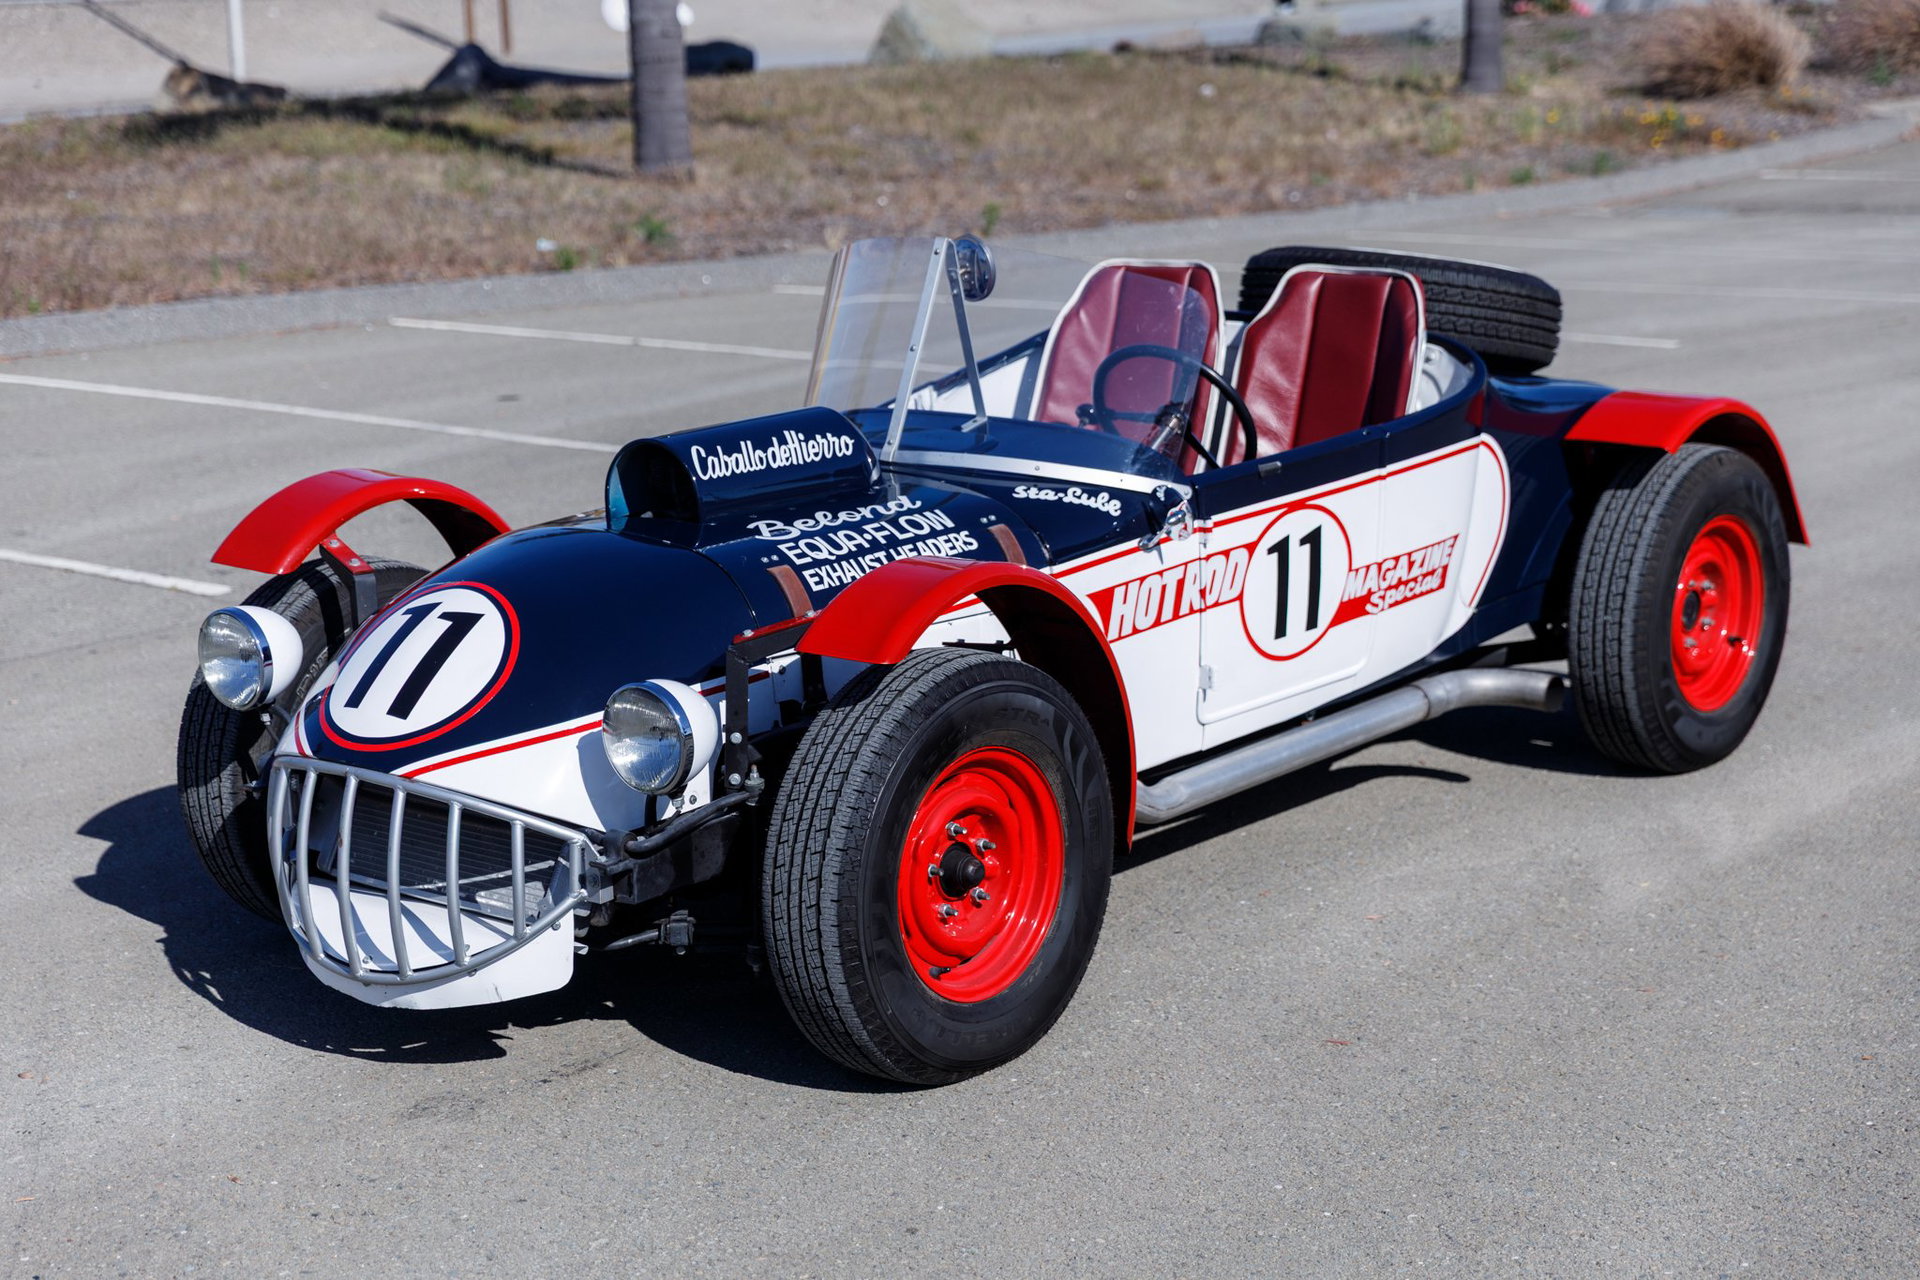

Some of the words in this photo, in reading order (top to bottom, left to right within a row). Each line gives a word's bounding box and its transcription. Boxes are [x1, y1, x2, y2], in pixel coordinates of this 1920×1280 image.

[691, 440, 767, 480] Caballo
[746, 495, 922, 540] Belond
[801, 550, 889, 592] EXHAUST
[1267, 524, 1323, 641] 11
[1340, 536, 1456, 604] MAGAZINE
[1364, 566, 1444, 615] Special
[344, 601, 486, 721] 11
